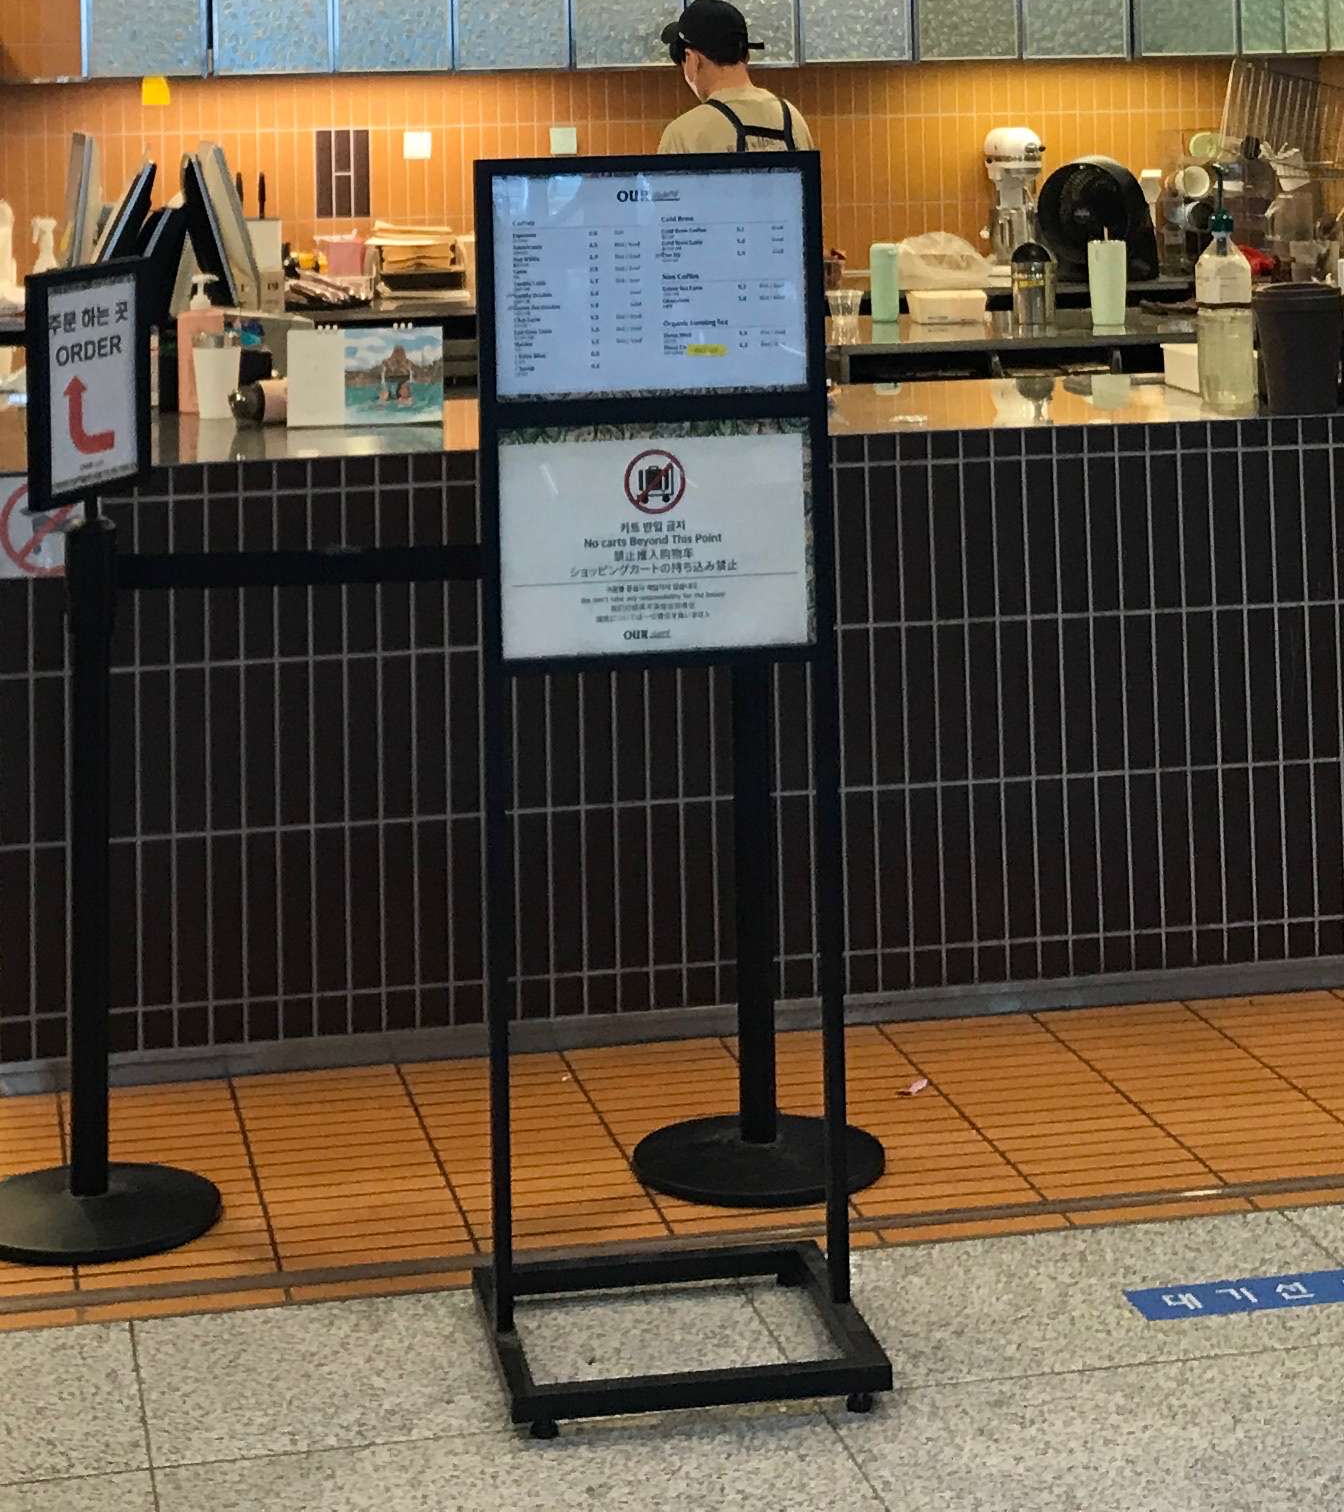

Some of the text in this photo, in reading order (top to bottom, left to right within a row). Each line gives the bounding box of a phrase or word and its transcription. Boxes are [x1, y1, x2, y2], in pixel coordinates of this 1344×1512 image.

[48, 301, 128, 336] 주문 하는 곳
[56, 334, 122, 367] ORDER
[584, 538, 599, 549] No
[601, 537, 627, 549] carts
[629, 535, 669, 549] Beyond
[695, 532, 722, 544] Point
